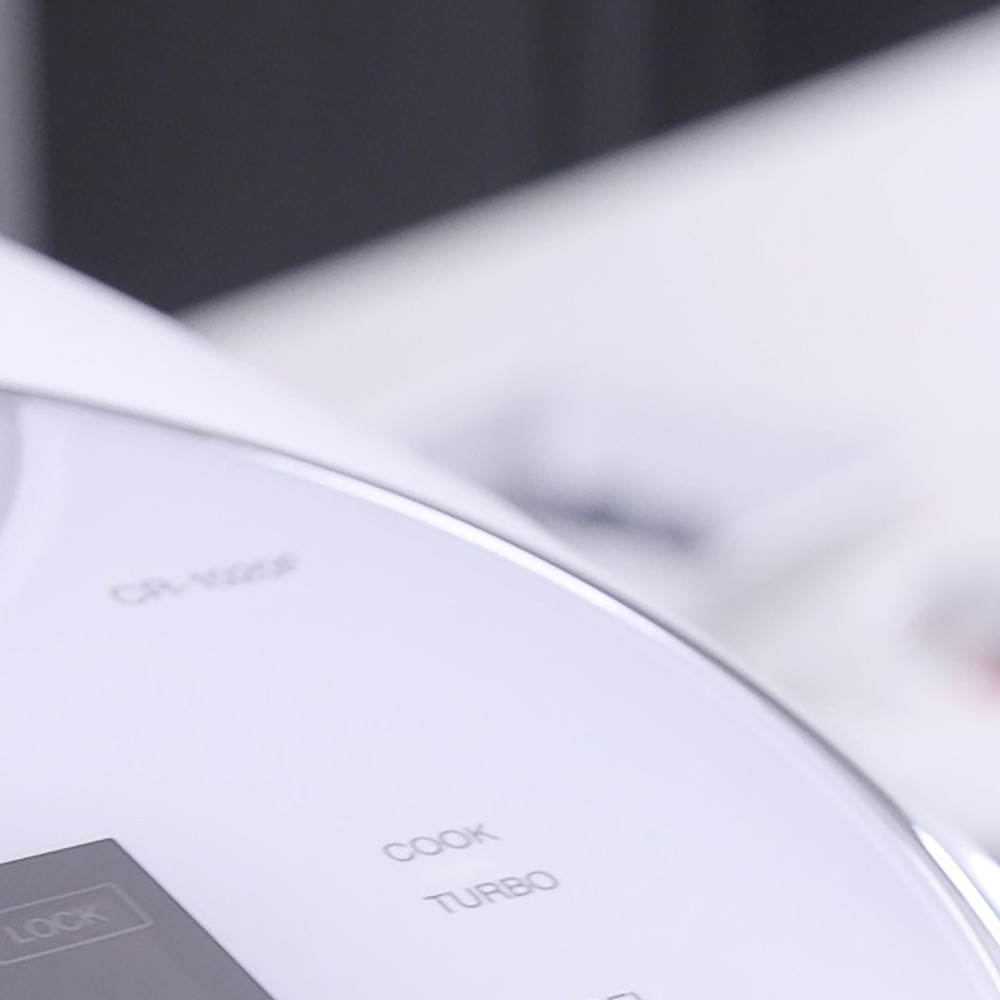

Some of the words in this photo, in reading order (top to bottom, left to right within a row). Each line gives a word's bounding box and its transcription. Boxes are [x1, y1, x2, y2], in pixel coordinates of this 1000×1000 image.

[382, 824, 500, 862] COOK
[423, 870, 560, 914] TURBO
[3, 904, 110, 944] LOCK
